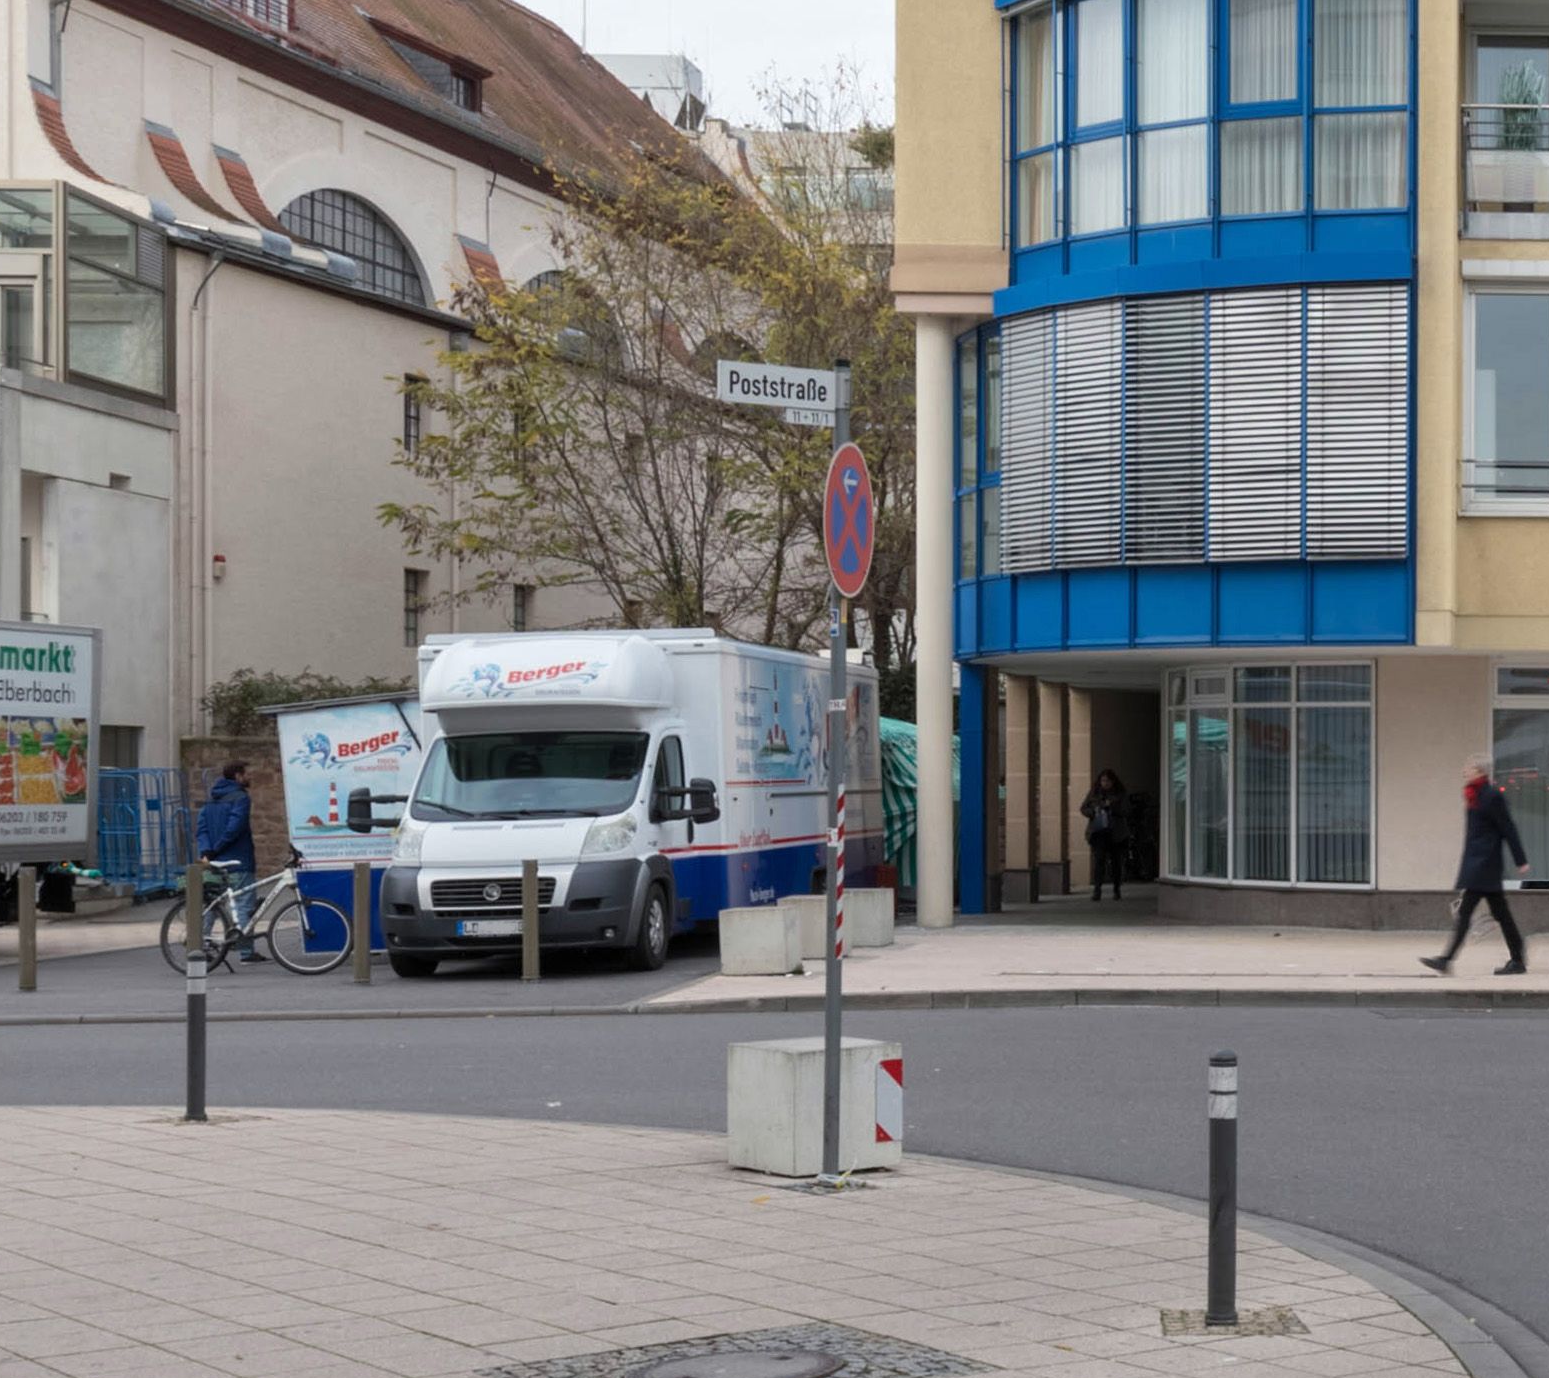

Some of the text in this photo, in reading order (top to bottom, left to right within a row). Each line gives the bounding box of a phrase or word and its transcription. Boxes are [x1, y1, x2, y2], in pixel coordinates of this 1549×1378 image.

[729, 370, 827, 402] Poststraße
[507, 660, 587, 684] Berger
[337, 730, 399, 757] Berger
